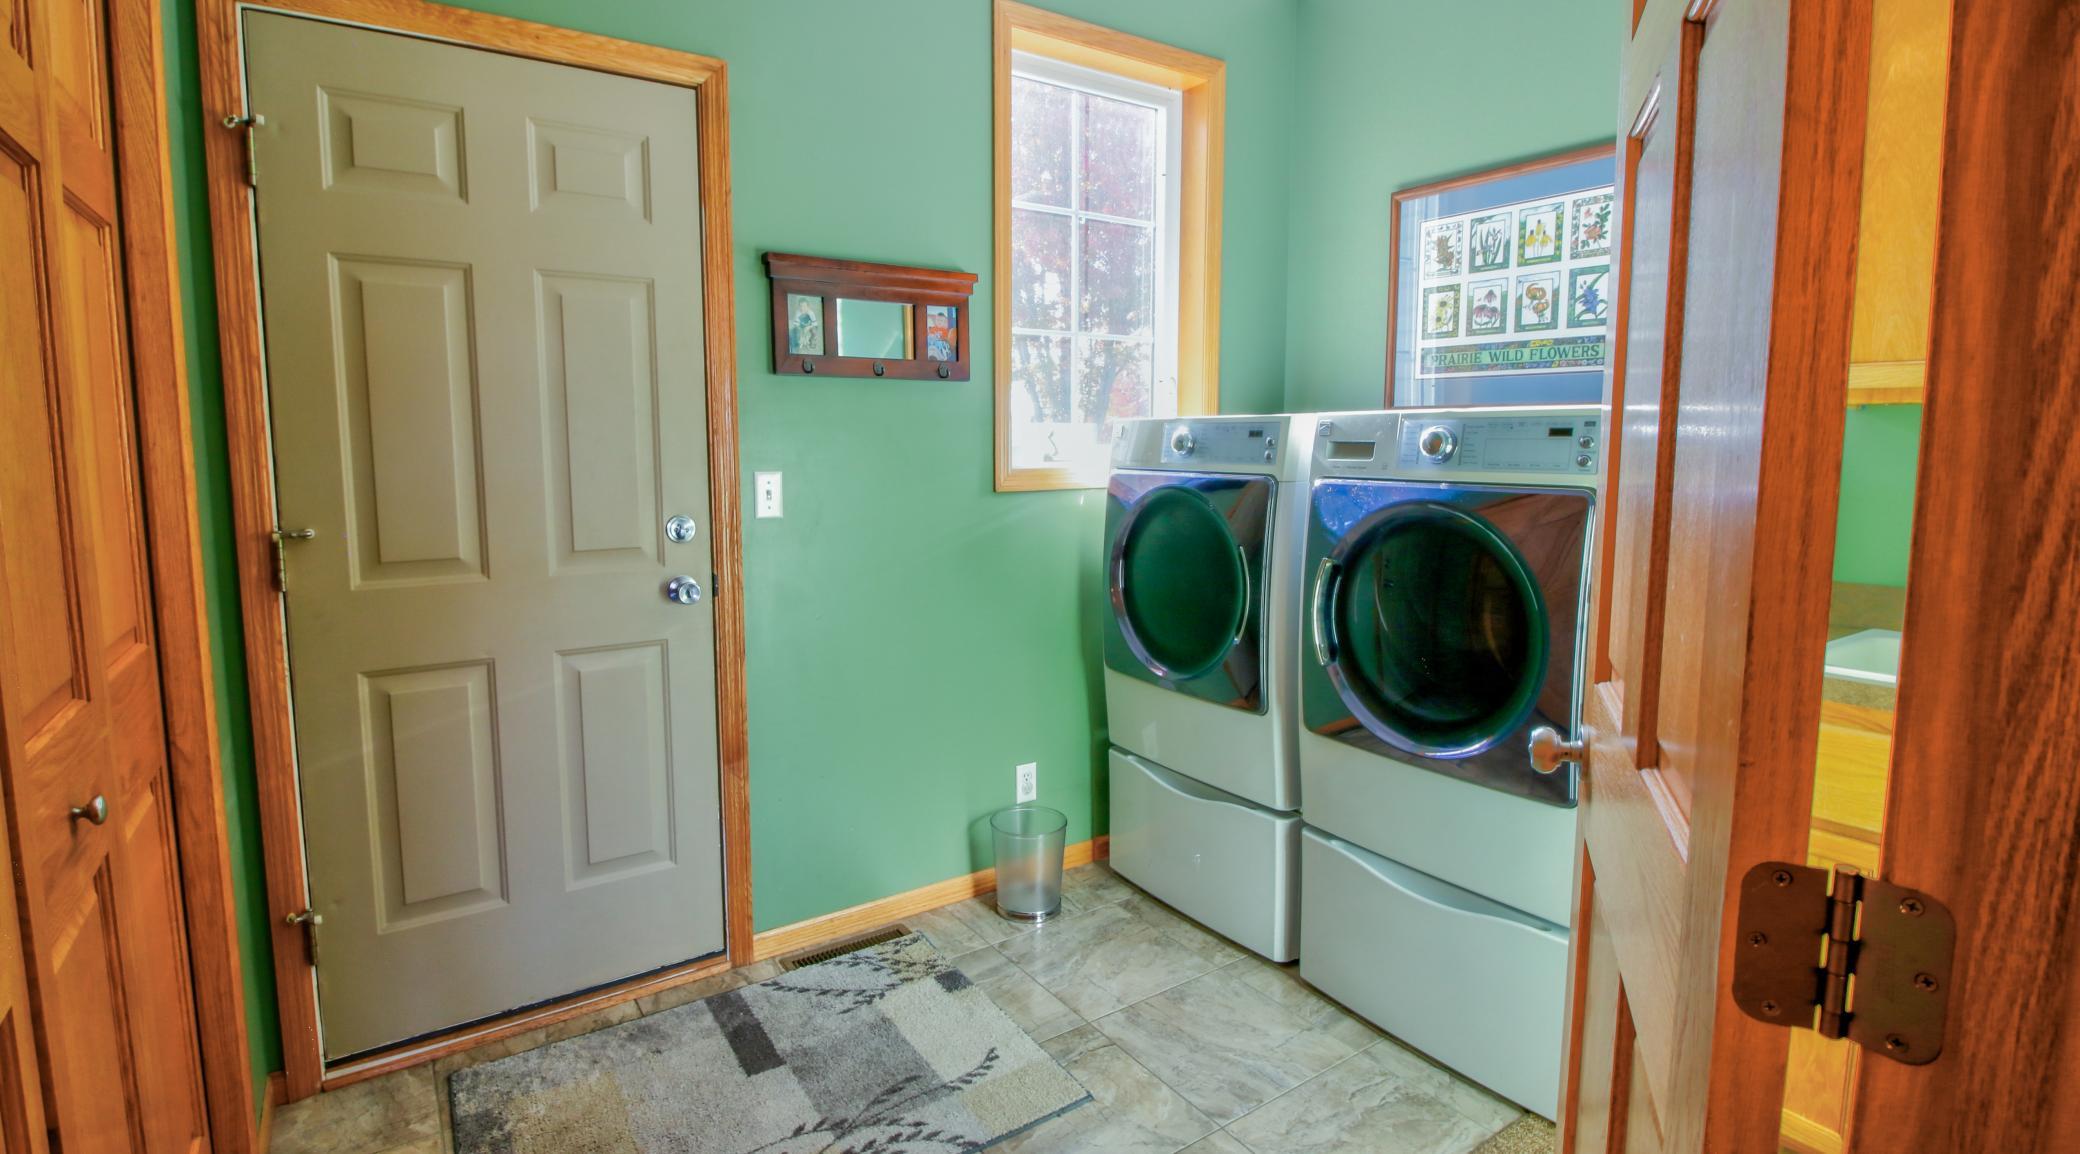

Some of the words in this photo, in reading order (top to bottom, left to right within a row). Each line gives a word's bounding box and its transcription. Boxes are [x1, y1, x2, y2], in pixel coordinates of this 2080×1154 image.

[1430, 351, 1482, 367] PRAIRIE
[1488, 349, 1524, 363] WILD
[1529, 344, 1601, 361] FLOWERS
